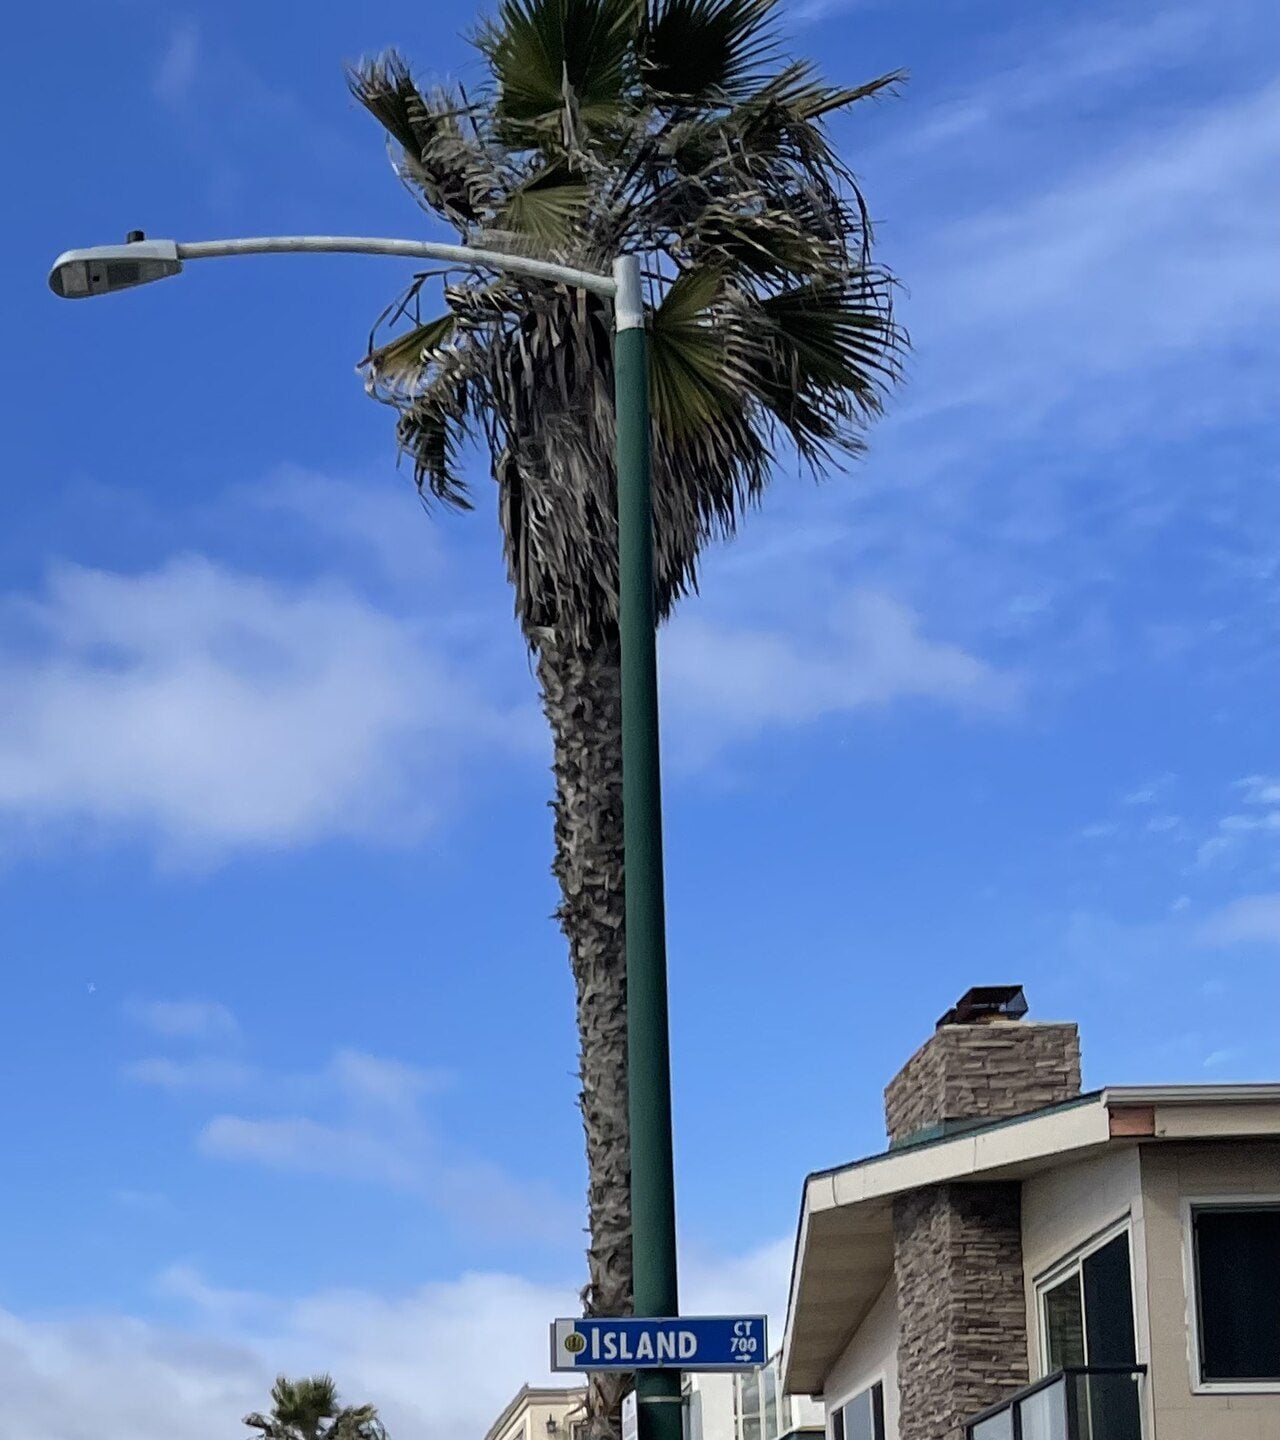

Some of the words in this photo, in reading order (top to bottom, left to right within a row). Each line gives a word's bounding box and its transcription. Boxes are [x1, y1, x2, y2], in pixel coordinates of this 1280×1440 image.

[734, 1321, 752, 1336] CT
[591, 1327, 698, 1360] ISLAND
[730, 1337, 757, 1352] 700
